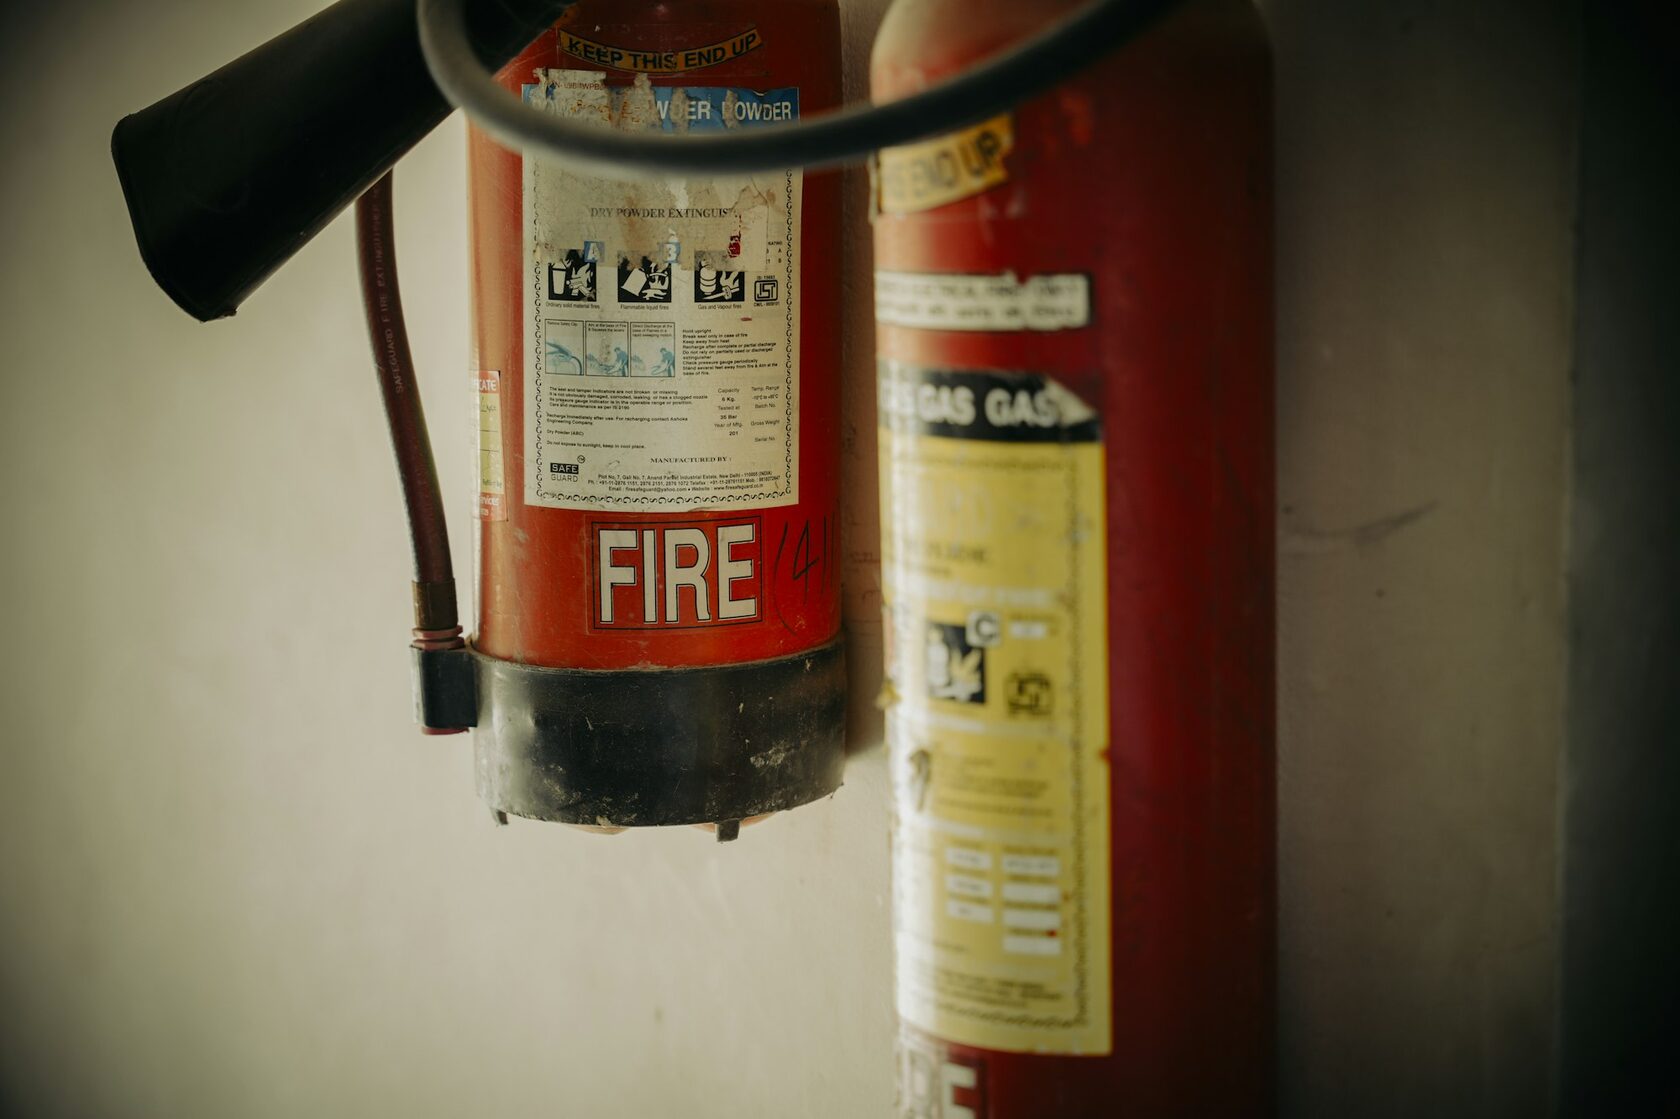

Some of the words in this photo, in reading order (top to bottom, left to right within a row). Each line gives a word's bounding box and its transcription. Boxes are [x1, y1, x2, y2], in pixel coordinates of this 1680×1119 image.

[568, 37, 623, 65] KEEP
[629, 52, 676, 70] THIS
[684, 47, 725, 68] END
[731, 33, 757, 58] UP
[722, 101, 792, 121] OWDER
[590, 208, 613, 218] DRY
[616, 208, 665, 218] POWDER
[384, 329, 404, 394] SAFEGUARD
[916, 382, 976, 427] GAS
[985, 387, 1061, 428] GAS
[551, 474, 579, 483] GUARD
[552, 464, 578, 474] SAFE
[598, 524, 757, 623] FIRE
[976, 613, 1001, 640] C
